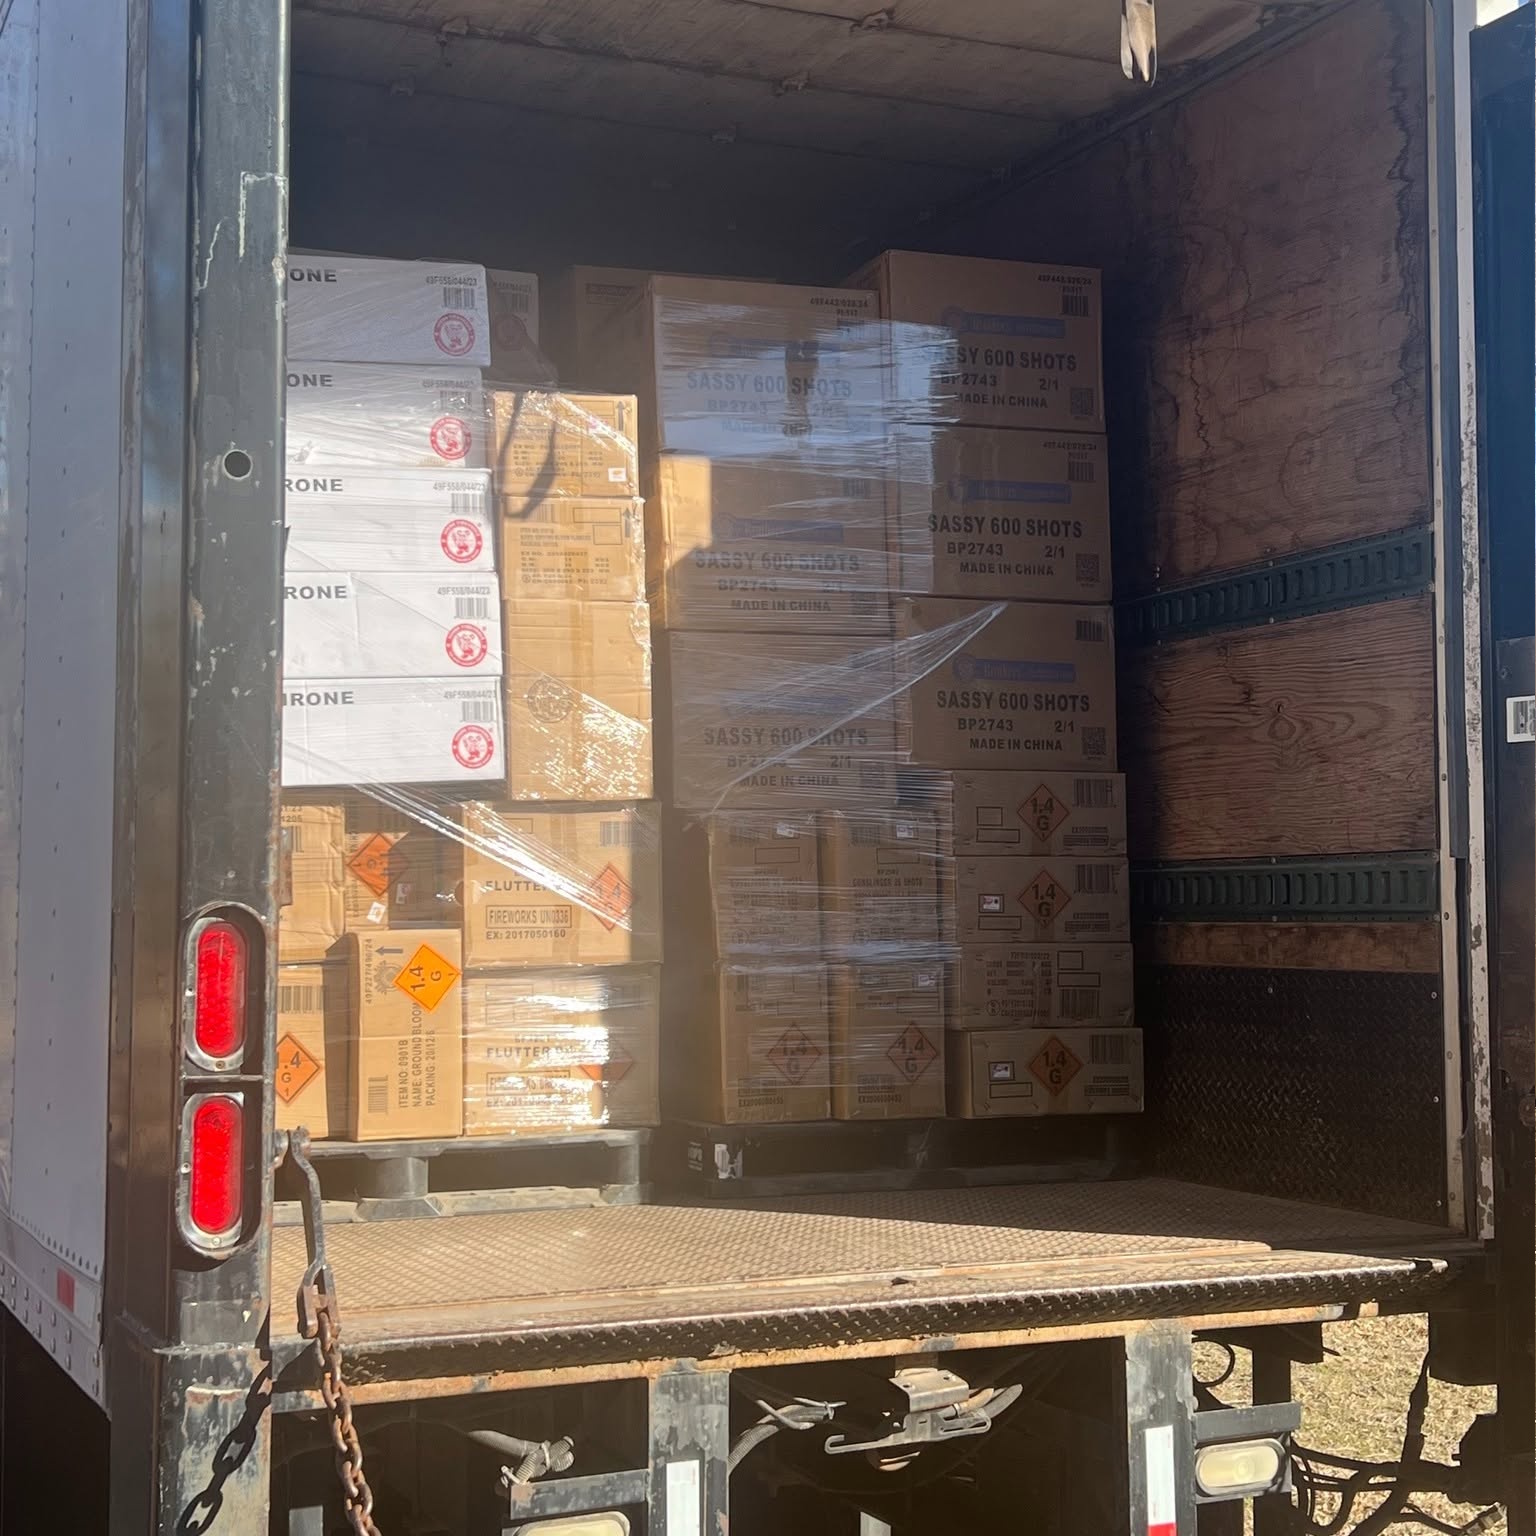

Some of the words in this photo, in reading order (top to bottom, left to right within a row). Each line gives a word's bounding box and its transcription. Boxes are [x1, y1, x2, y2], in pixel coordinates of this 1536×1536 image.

[984, 348, 1017, 369] 600
[1020, 351, 1078, 372] SHOTS
[1039, 376, 1060, 392] 2/1
[1008, 395, 1049, 410] CHINA
[927, 513, 987, 536] SASSY
[990, 516, 1022, 537] 600
[1025, 518, 1083, 540] SHOTS
[946, 541, 1005, 558] BP2743
[1044, 544, 1066, 560] 2/1
[959, 561, 995, 576] MADE
[998, 562, 1012, 577] IN
[1013, 562, 1055, 578] CHINA
[936, 690, 995, 711] SASSY
[999, 691, 1029, 712] 600
[1034, 693, 1090, 714] SHOTS
[957, 717, 1014, 732] BP2743
[1054, 719, 1076, 734] 2/1
[969, 737, 1006, 751] MADE
[1008, 738, 1021, 751] IN
[1023, 738, 1063, 752] CHINA
[1031, 883, 1056, 901] 1.4
[488, 910, 537, 925] FIREWORKS
[1038, 901, 1050, 917] G
[411, 1037, 422, 1076] GROUND
[1042, 1050, 1067, 1068] 1.4
[281, 1072, 292, 1084] G
[425, 1062, 436, 1107] PACKING:
[1049, 1069, 1062, 1084] G
[398, 1085, 409, 1109] ITEM
